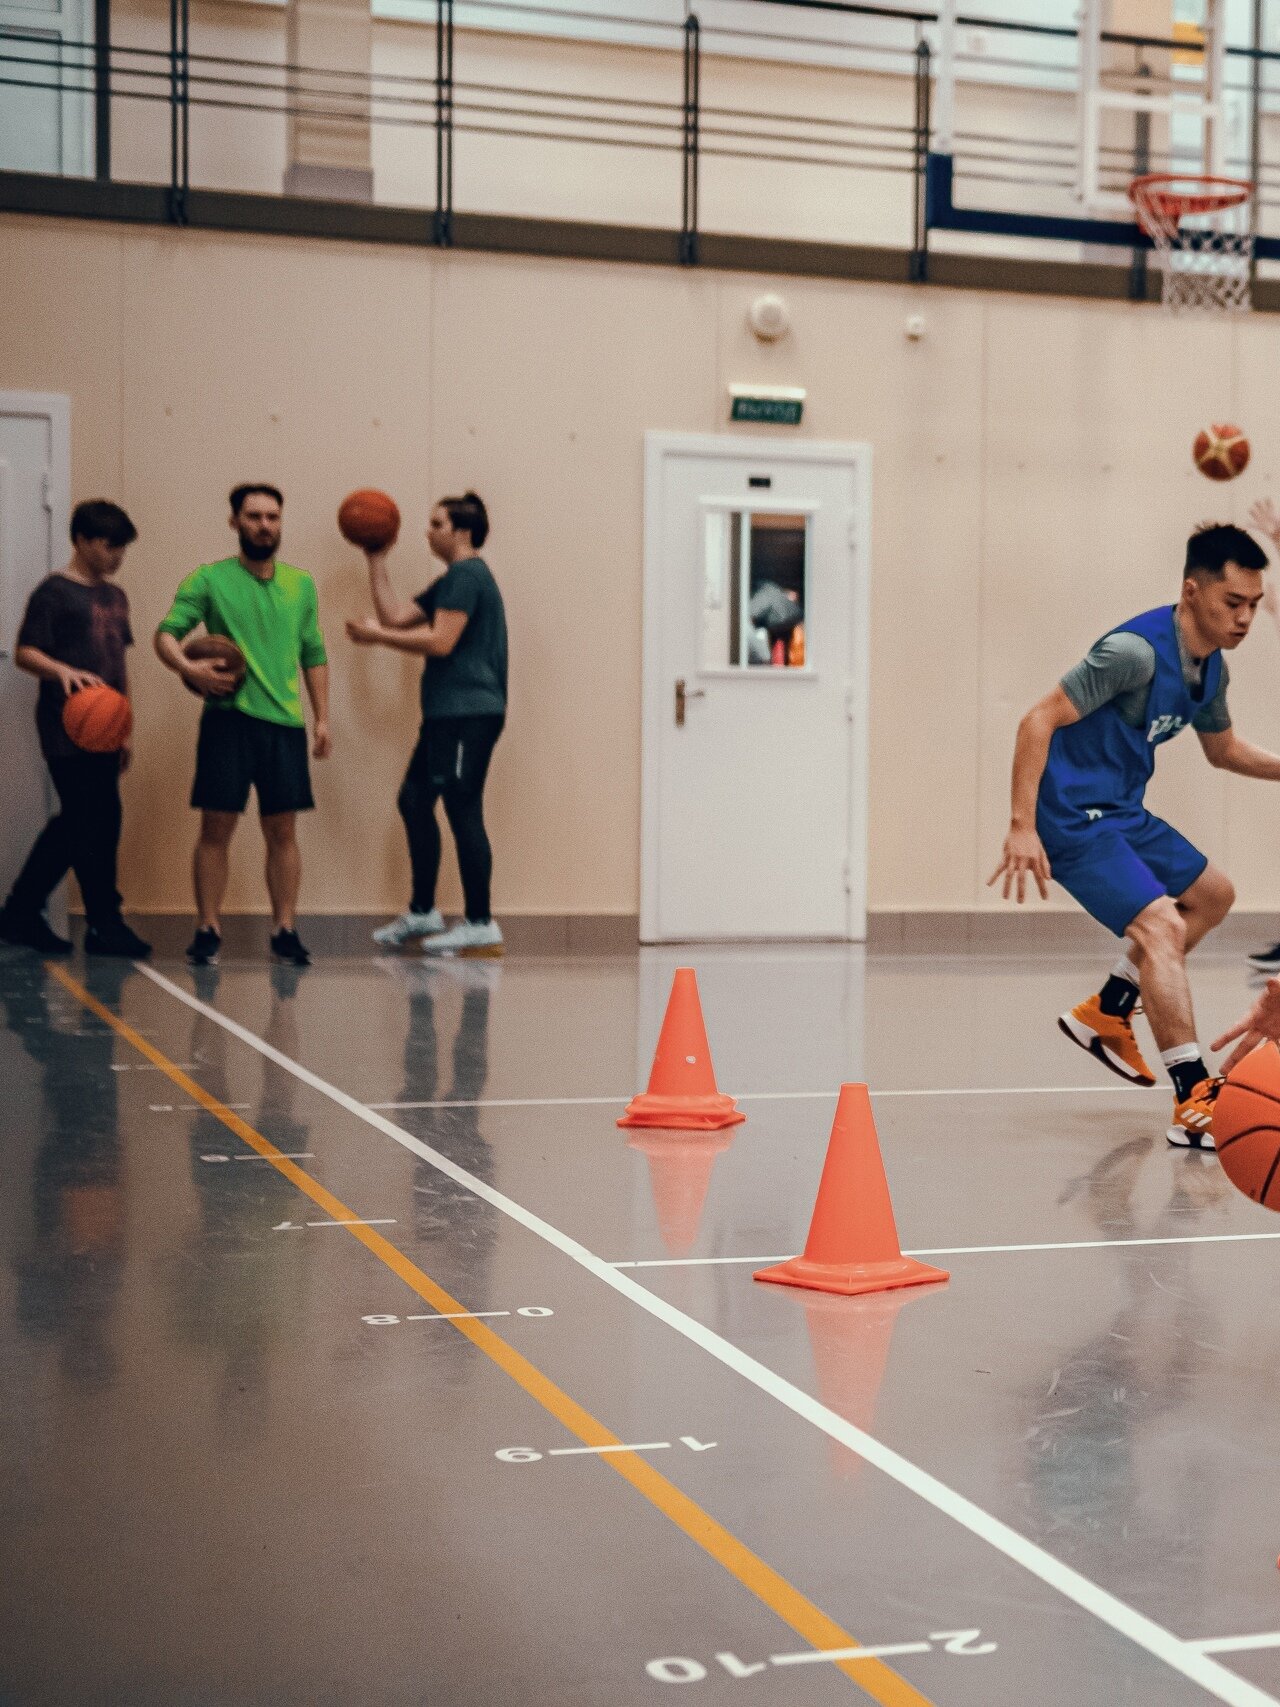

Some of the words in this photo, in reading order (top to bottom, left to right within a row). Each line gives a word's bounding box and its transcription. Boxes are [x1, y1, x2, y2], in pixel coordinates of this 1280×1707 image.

[516, 1306, 554, 1317] 0
[361, 1314, 401, 1325] 8
[679, 1436, 718, 1451] 1
[494, 1447, 543, 1463] 9
[929, 1628, 998, 1655] 2
[645, 1651, 767, 1683] 10
